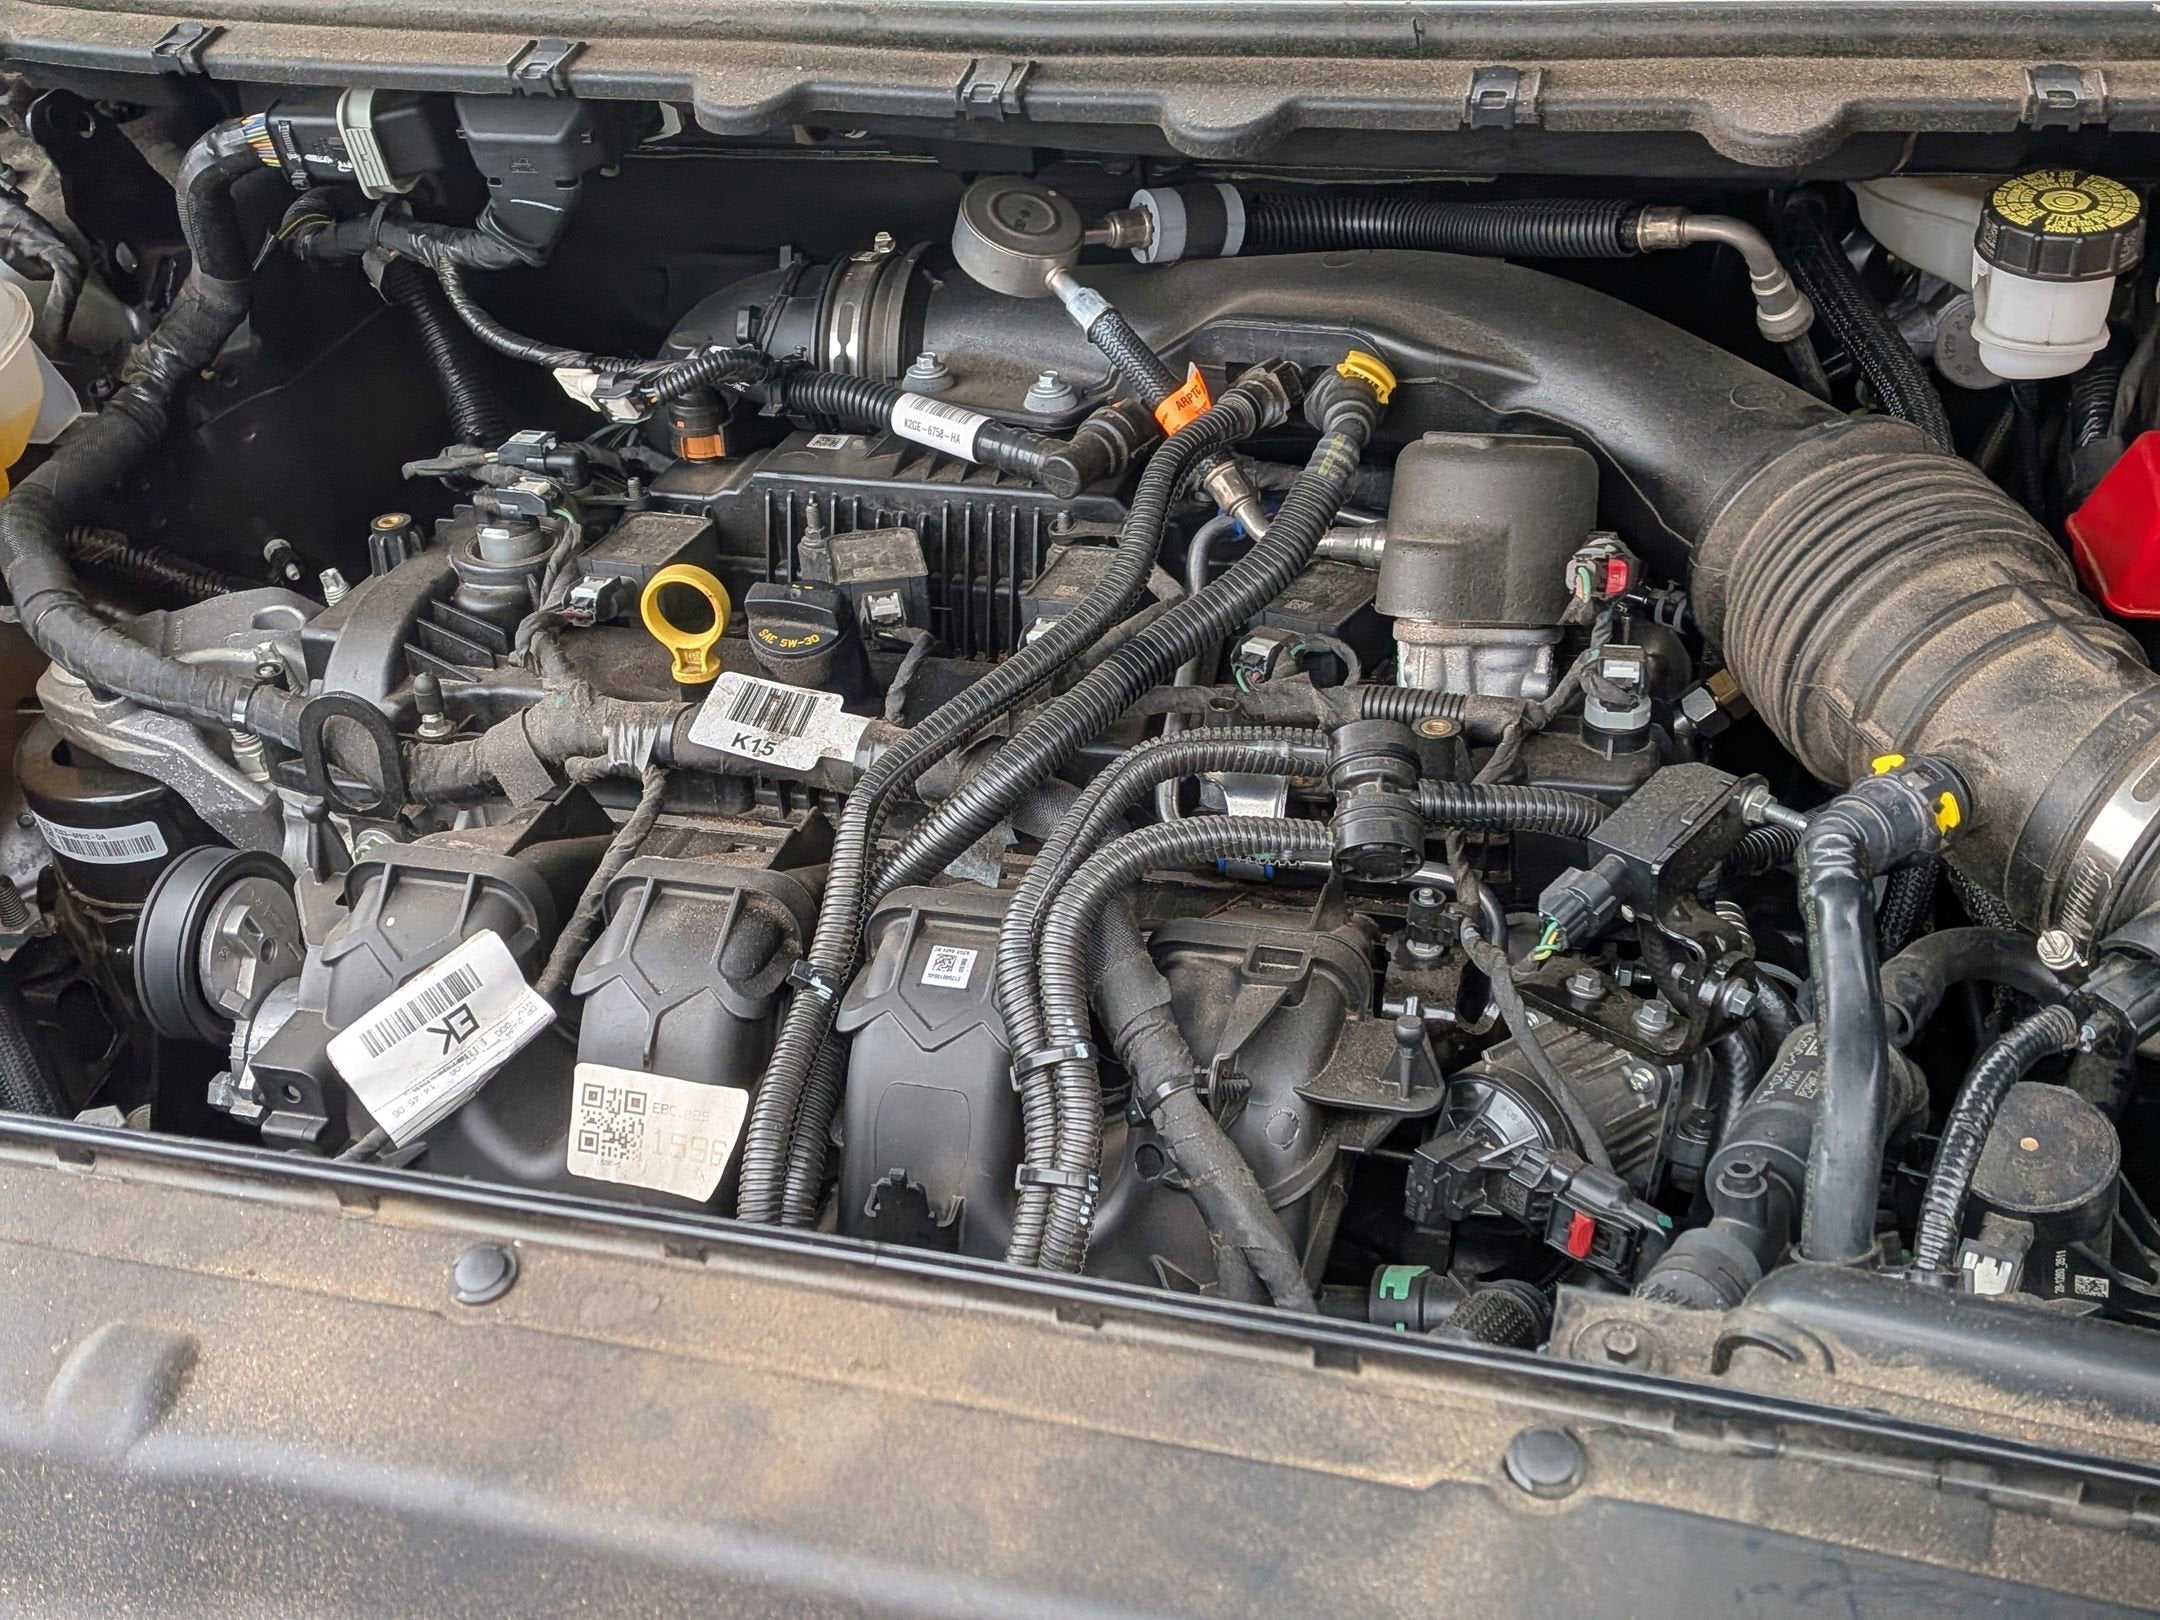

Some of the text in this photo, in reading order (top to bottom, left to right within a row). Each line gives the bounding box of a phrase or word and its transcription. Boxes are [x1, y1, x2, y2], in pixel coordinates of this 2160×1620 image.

[758, 628, 820, 649] SAE 5W-30
[731, 732, 777, 757] K15
[426, 1003, 480, 1056] EK
